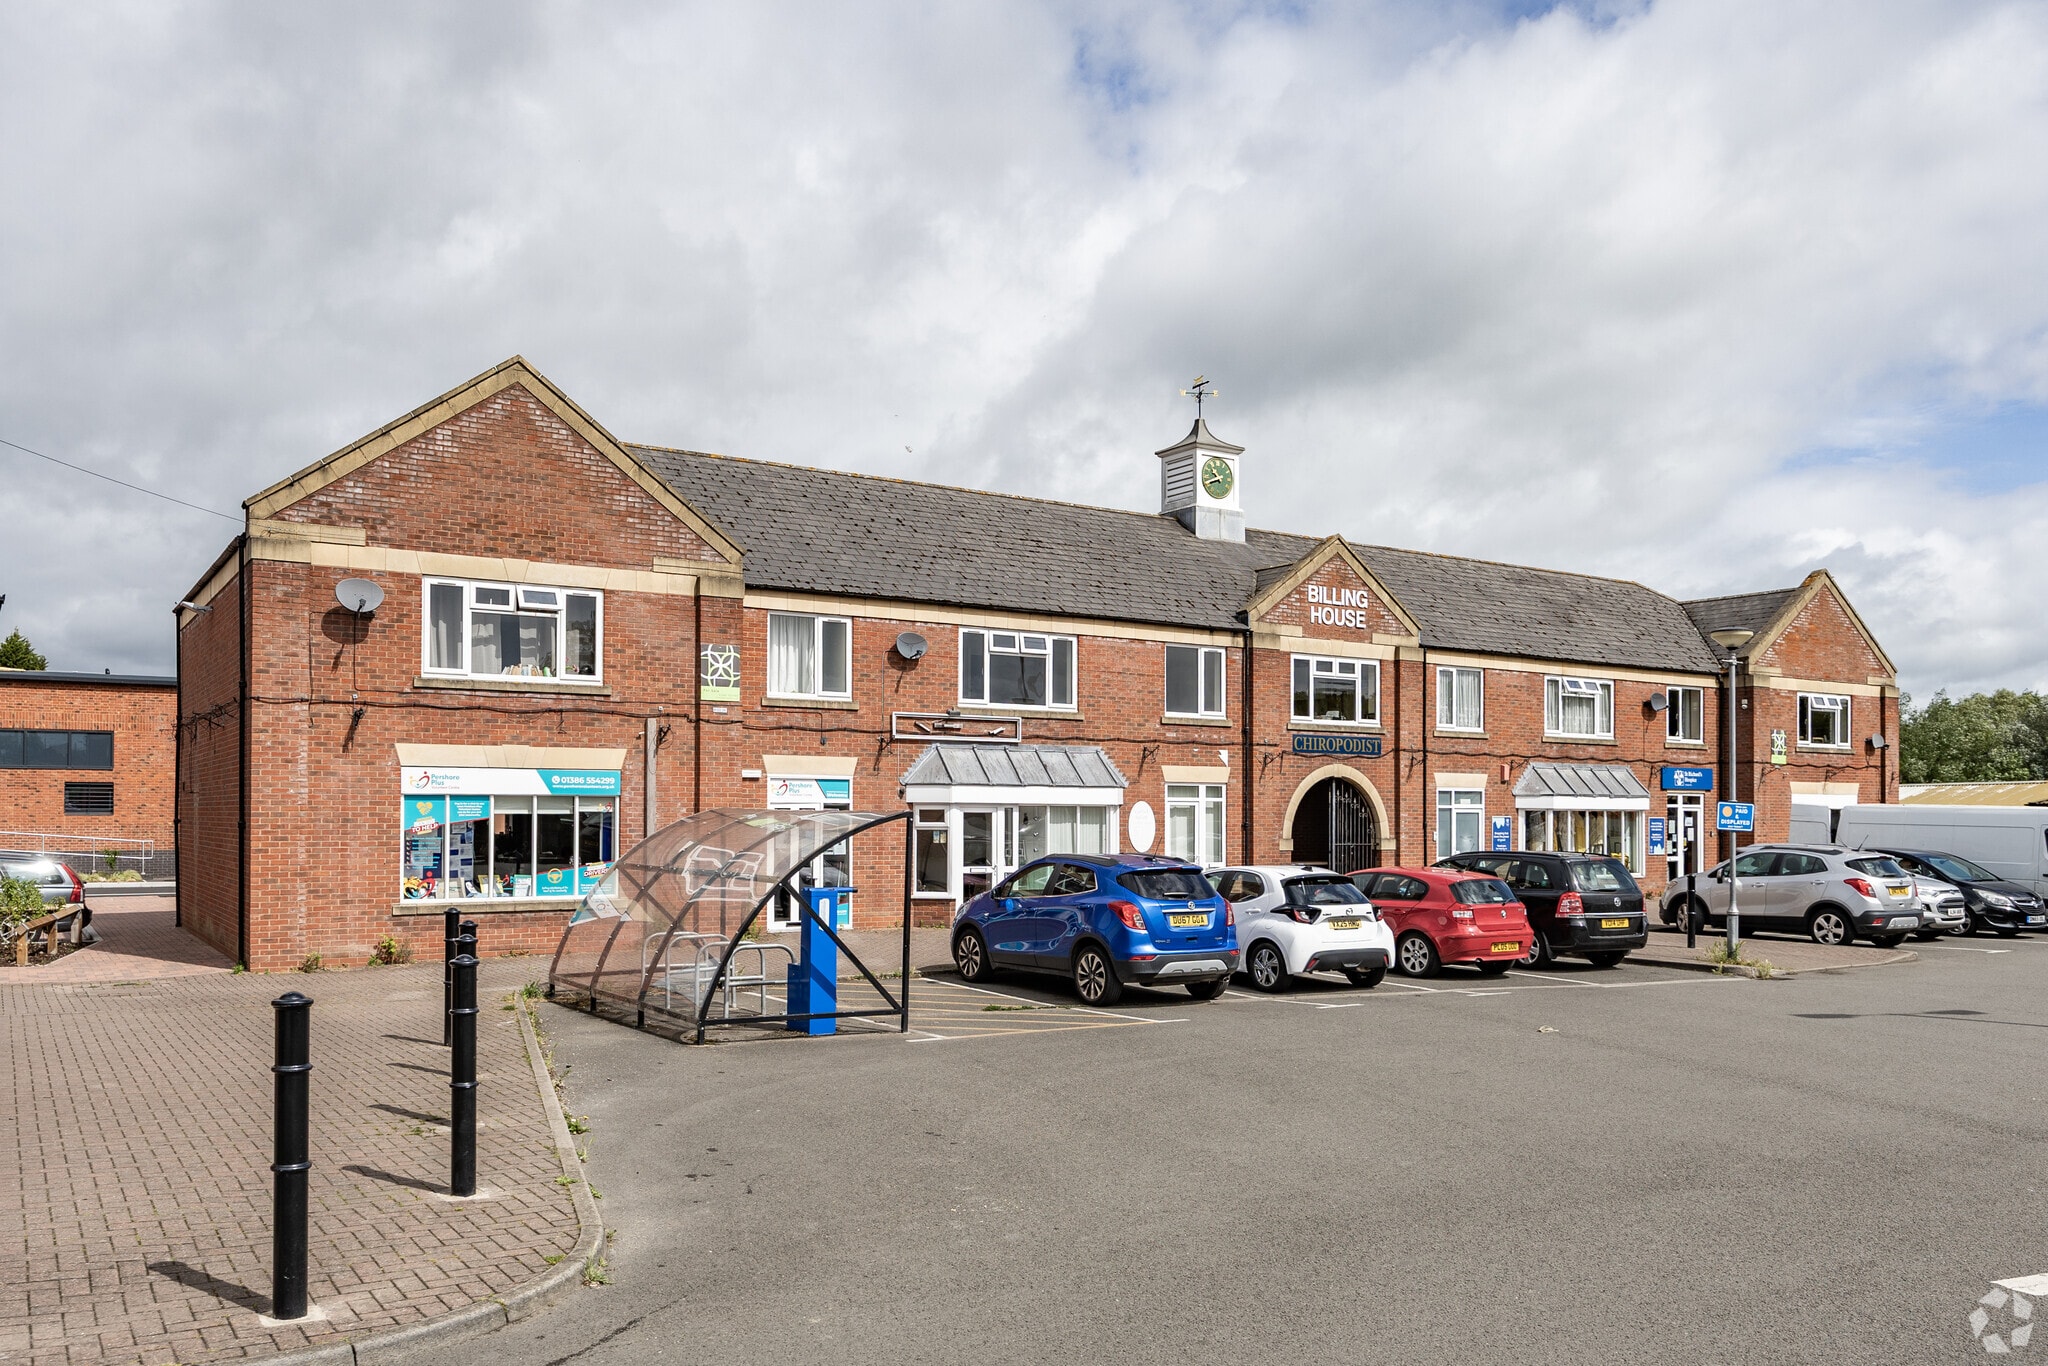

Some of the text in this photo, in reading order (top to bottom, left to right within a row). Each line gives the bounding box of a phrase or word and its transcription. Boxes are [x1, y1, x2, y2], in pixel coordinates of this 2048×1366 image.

[1308, 584, 1368, 609] BILLING
[1310, 605, 1366, 629] HOUSE
[1294, 736, 1380, 753] CHIROPODIST
[431, 773, 460, 781] Pershore
[561, 776, 616, 785] 01386 554299
[411, 822, 440, 833] TO HELP
